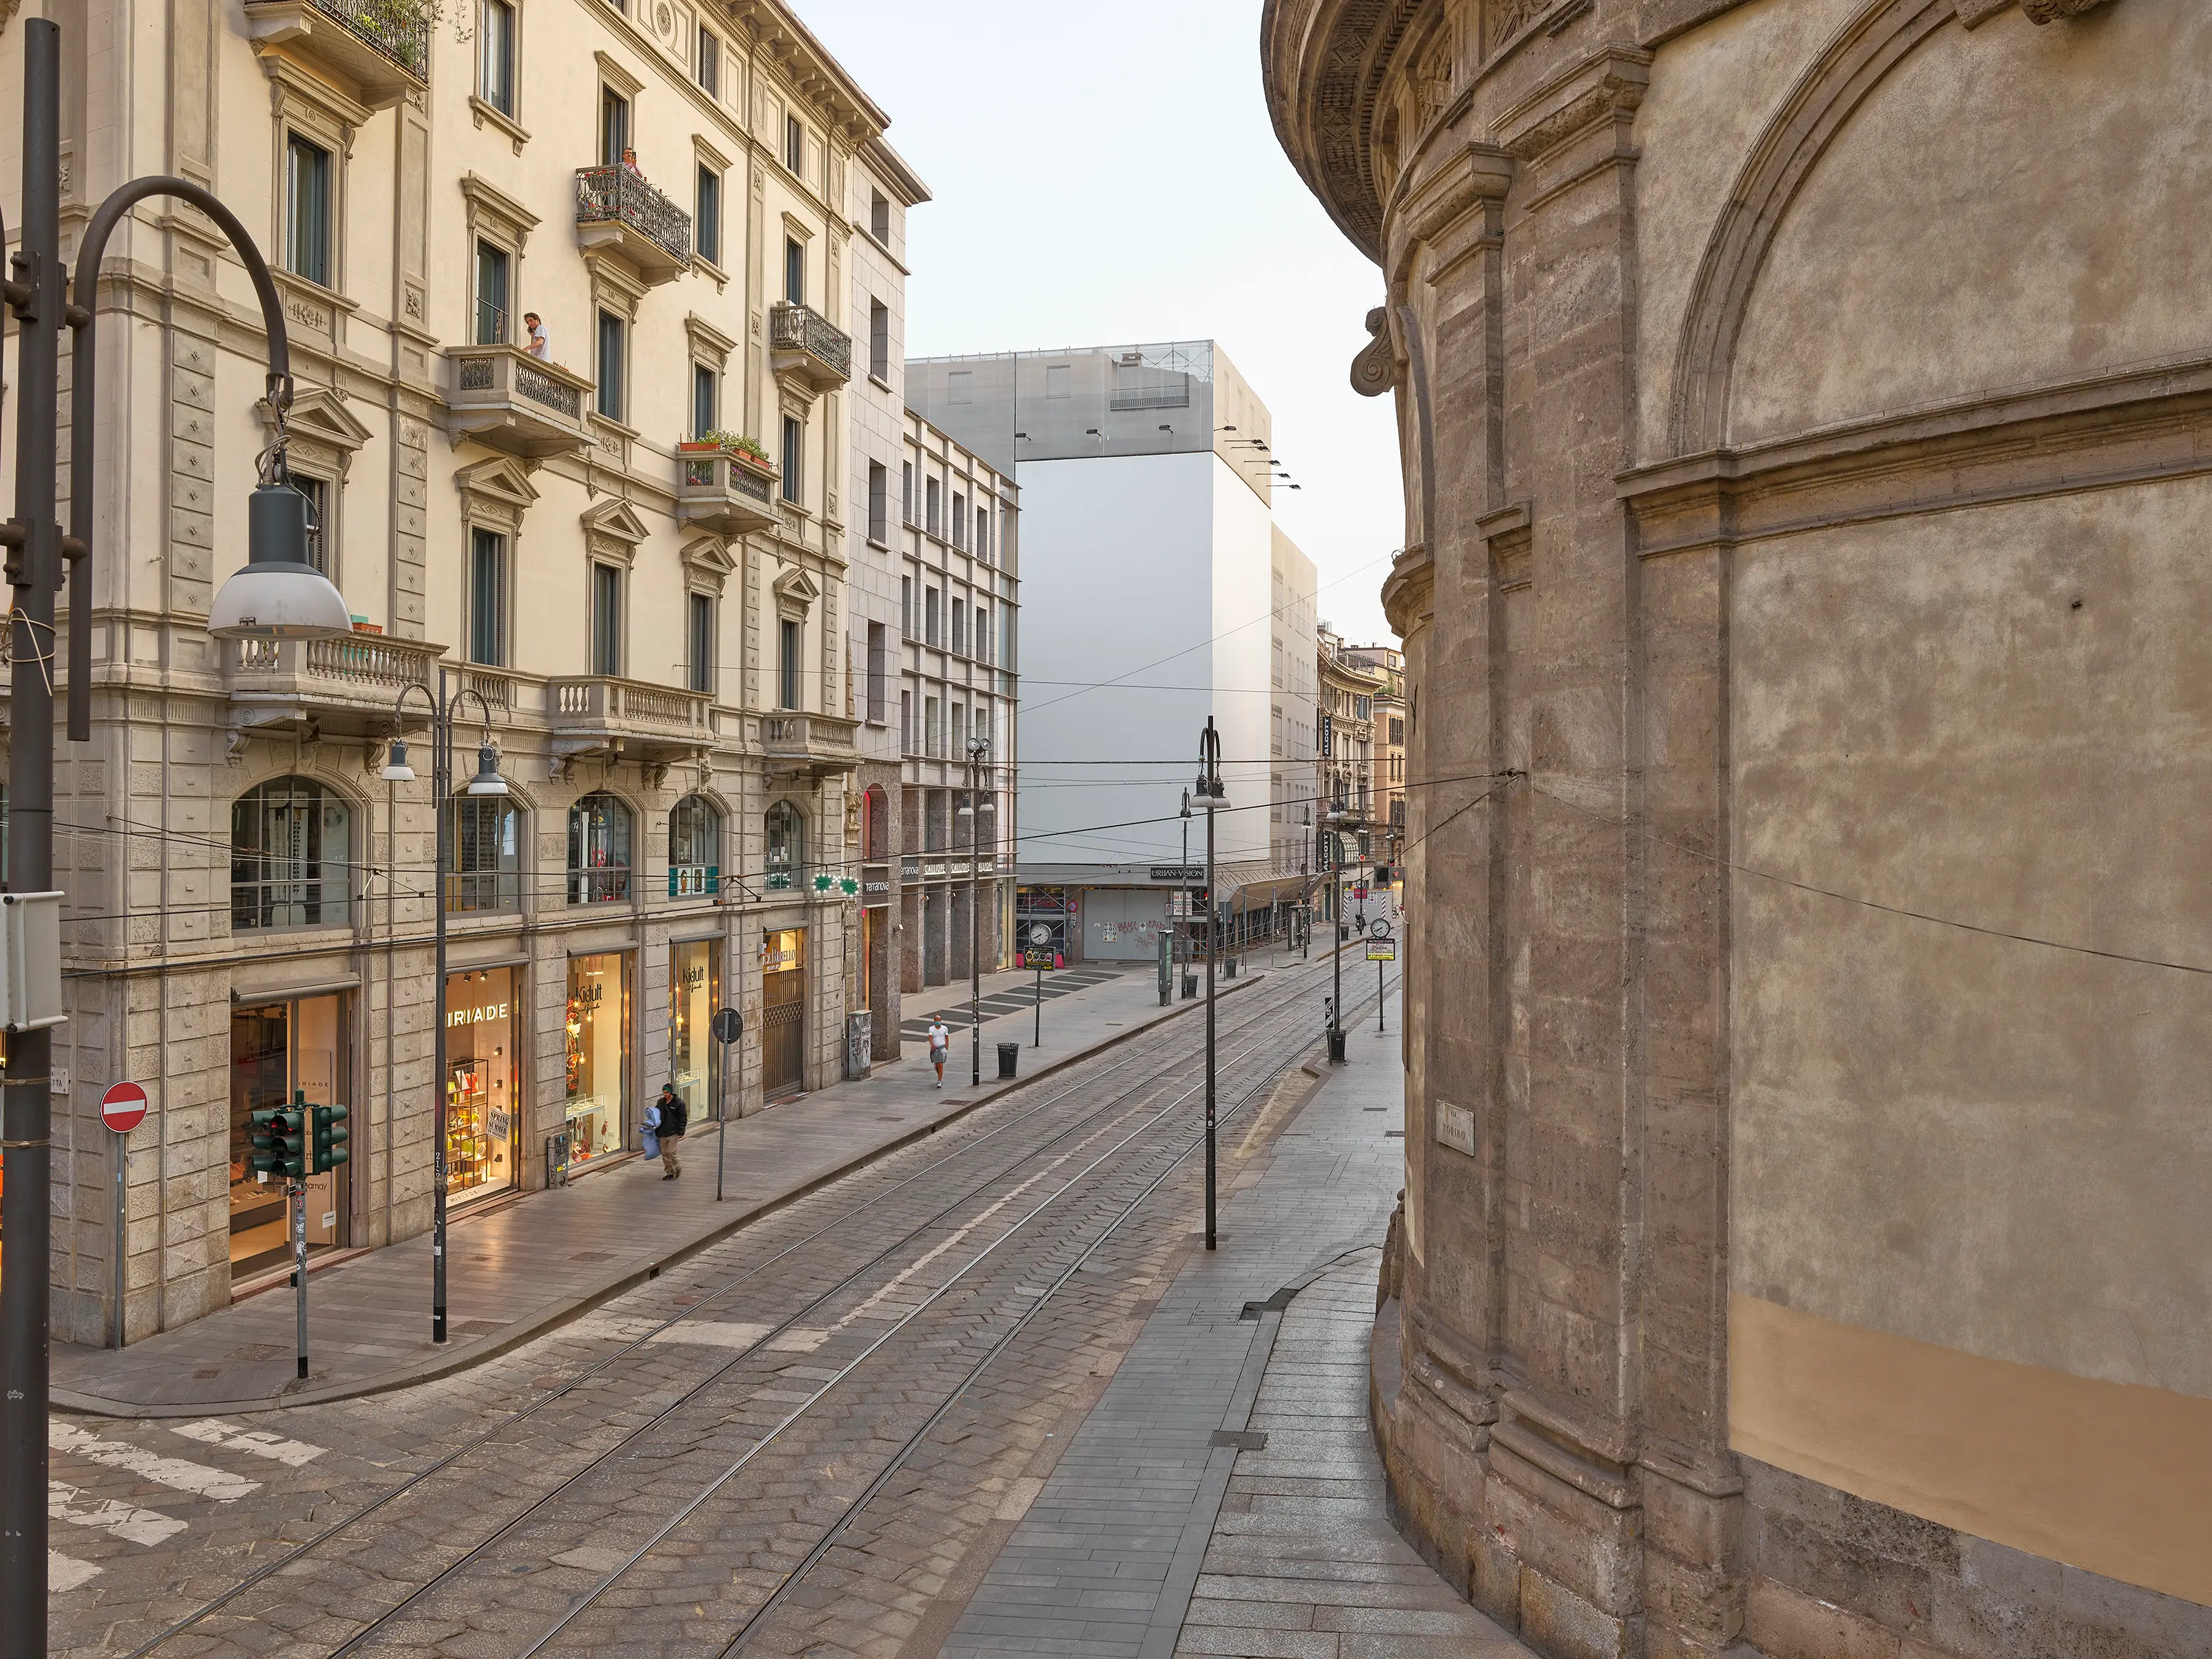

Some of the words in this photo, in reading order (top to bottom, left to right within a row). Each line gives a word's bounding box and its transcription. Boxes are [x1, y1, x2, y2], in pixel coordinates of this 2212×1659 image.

[900, 866, 919, 875] erranova
[925, 863, 945, 873] CALLIOPE
[951, 862, 970, 872] CALLIOPE
[978, 861, 993, 871] ALLIOPE
[772, 947, 796, 963] BARELLO
[683, 966, 704, 984] Kidult
[576, 984, 602, 1003] Kidult
[445, 1003, 508, 1028] IRIADE
[52, 1079, 63, 1087] TTA
[490, 1111, 509, 1125] SPRING
[488, 1121, 507, 1135] SUMMER
[1443, 1123, 1466, 1141] TORINO
[450, 1189, 479, 1203] MIRIADE
